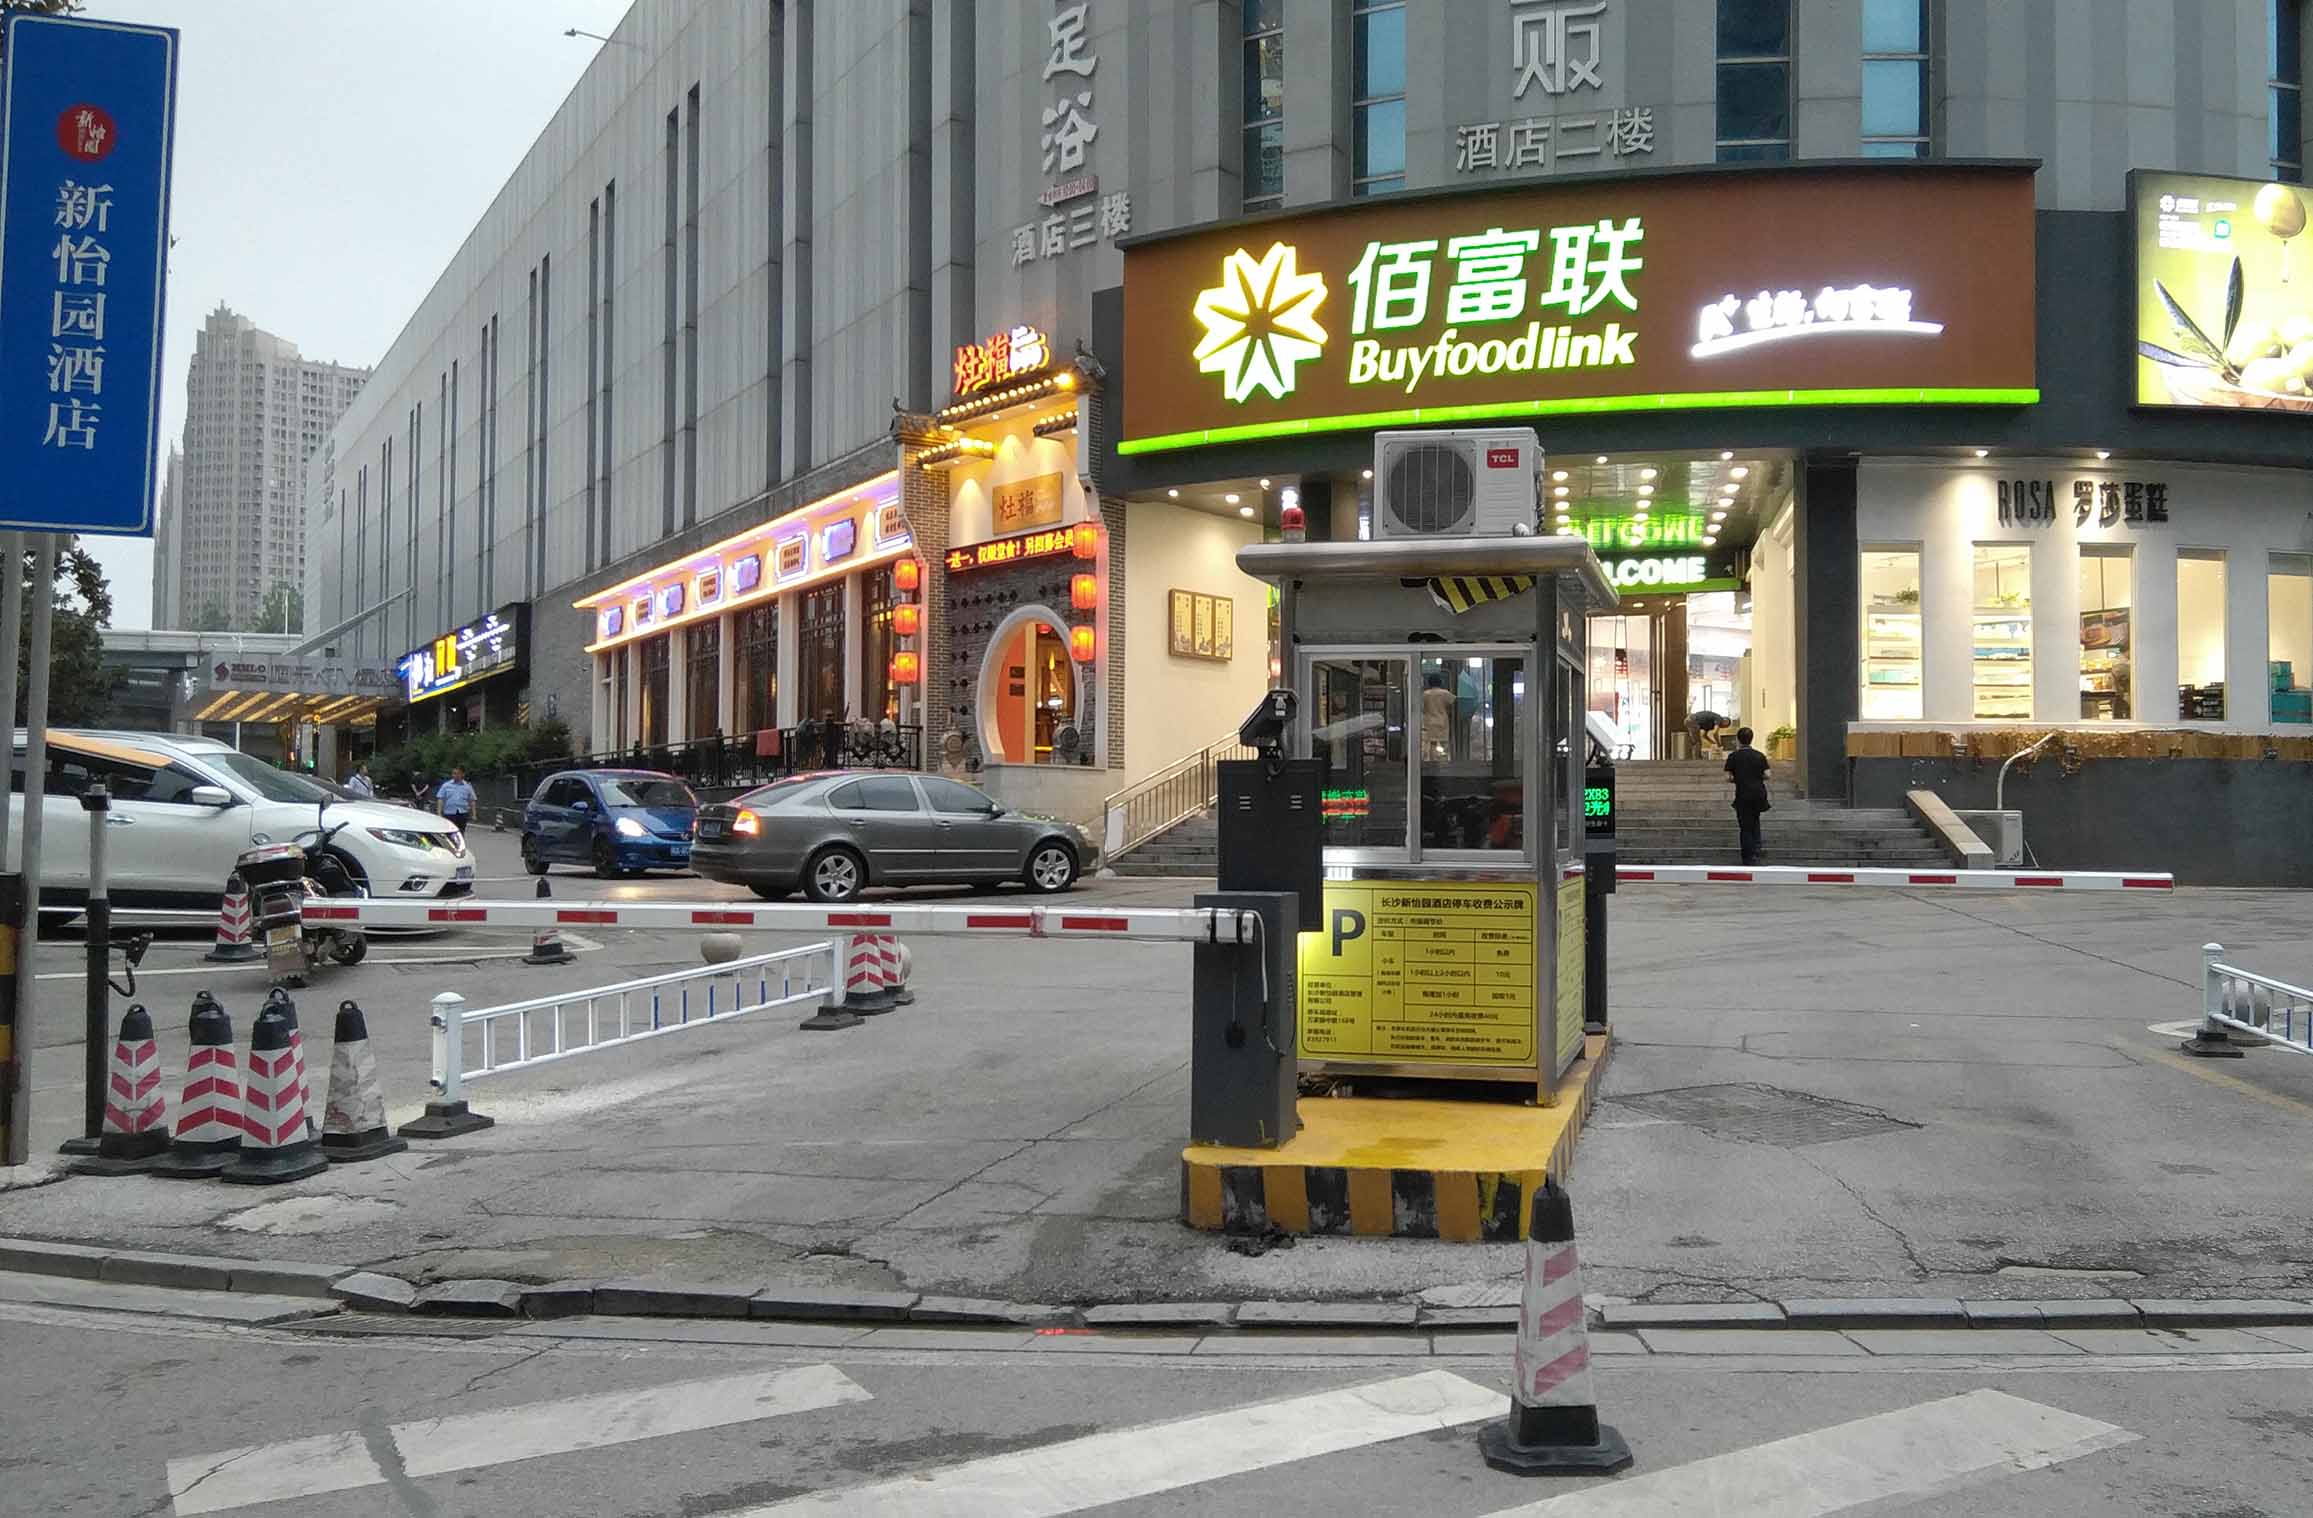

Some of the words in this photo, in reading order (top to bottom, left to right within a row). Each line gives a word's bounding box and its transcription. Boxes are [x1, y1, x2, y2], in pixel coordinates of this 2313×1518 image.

[1041, 2, 1099, 174] 足浴
[1456, 106, 1655, 173] 酒店二楼
[1010, 191, 1134, 272] 酒店三楼
[1347, 217, 1645, 336] 佰富联
[42, 179, 115, 451] 新怡园酒店
[1348, 320, 1640, 395] Buyfoodlink
[1491, 454, 1515, 464] TCL
[1997, 480, 2057, 521] ROSA
[2073, 480, 2169, 523] 罗莎蛋糕
[1331, 908, 1367, 957] P
[1381, 896, 1524, 911] 长沙新怡园酒店停车收费公示牌
